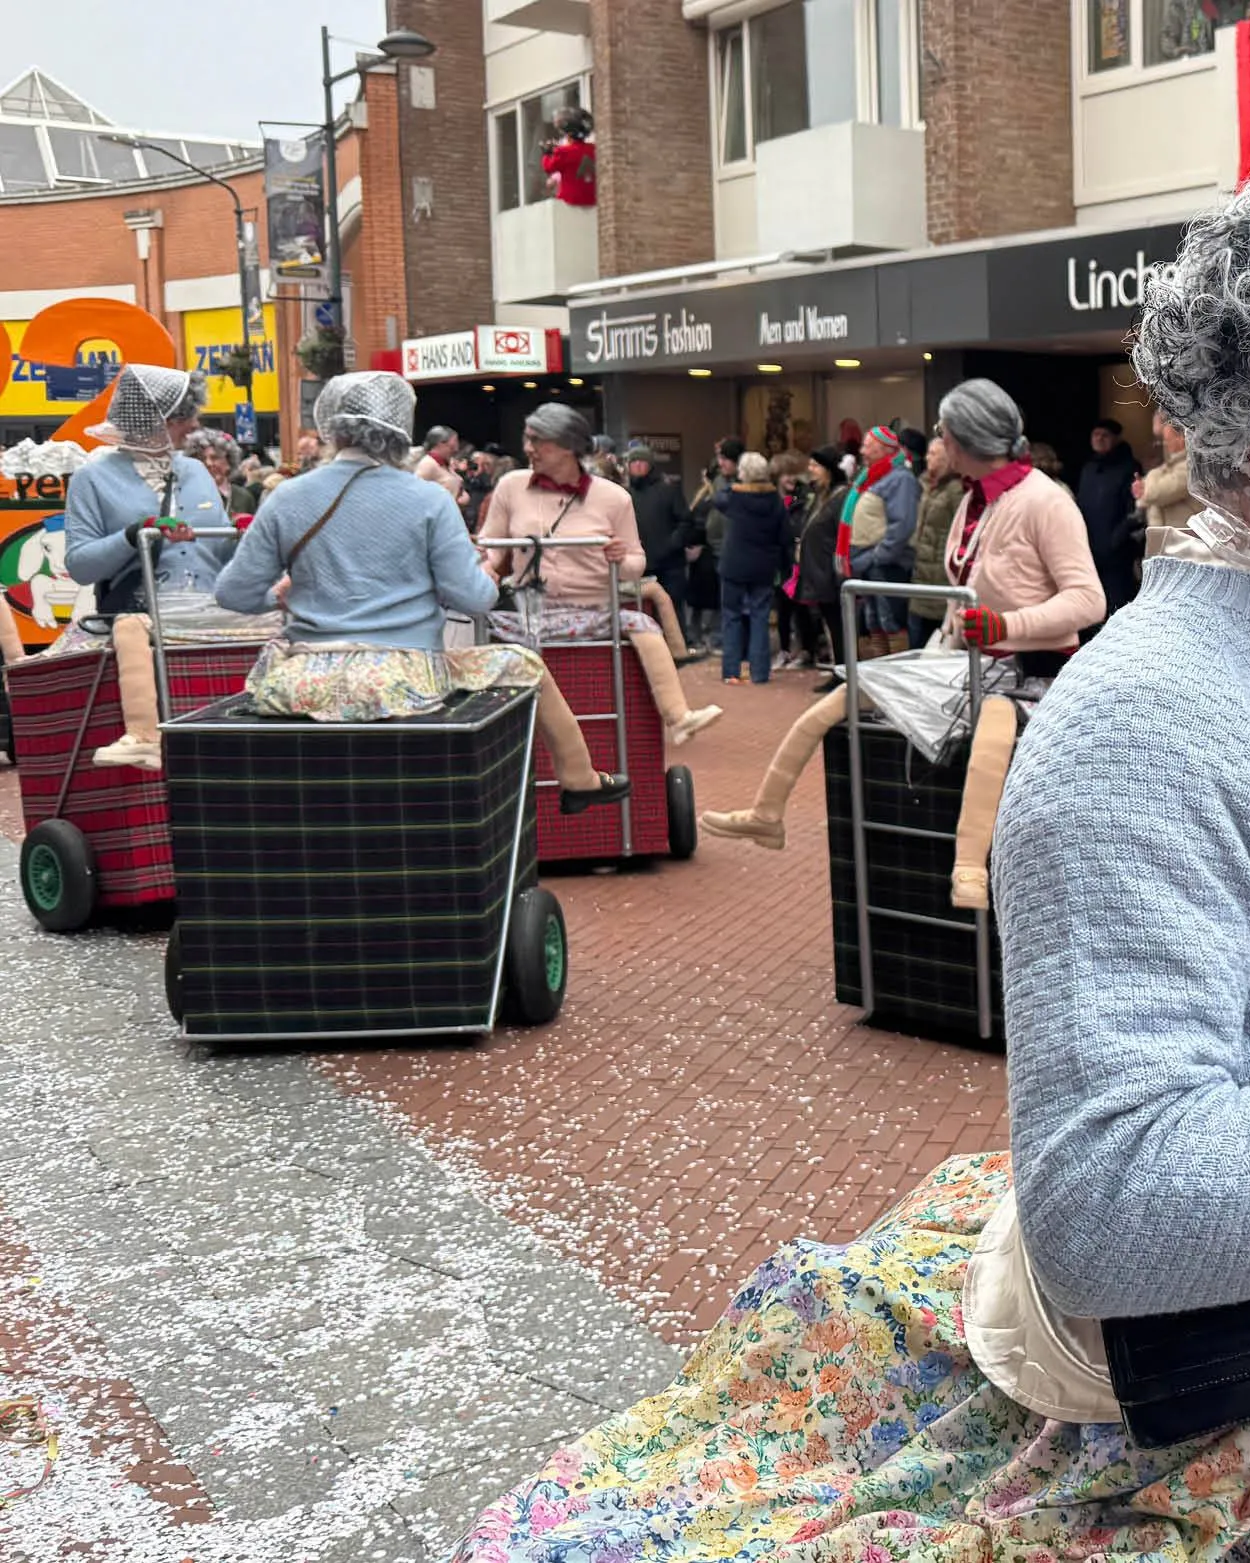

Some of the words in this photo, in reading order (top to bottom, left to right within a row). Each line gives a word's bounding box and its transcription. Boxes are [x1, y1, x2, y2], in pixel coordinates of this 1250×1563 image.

[663, 307, 712, 356] Fashion
[760, 311, 782, 346] Men
[784, 306, 804, 342] and
[806, 305, 848, 341] Women
[421, 343, 448, 370] HANS
